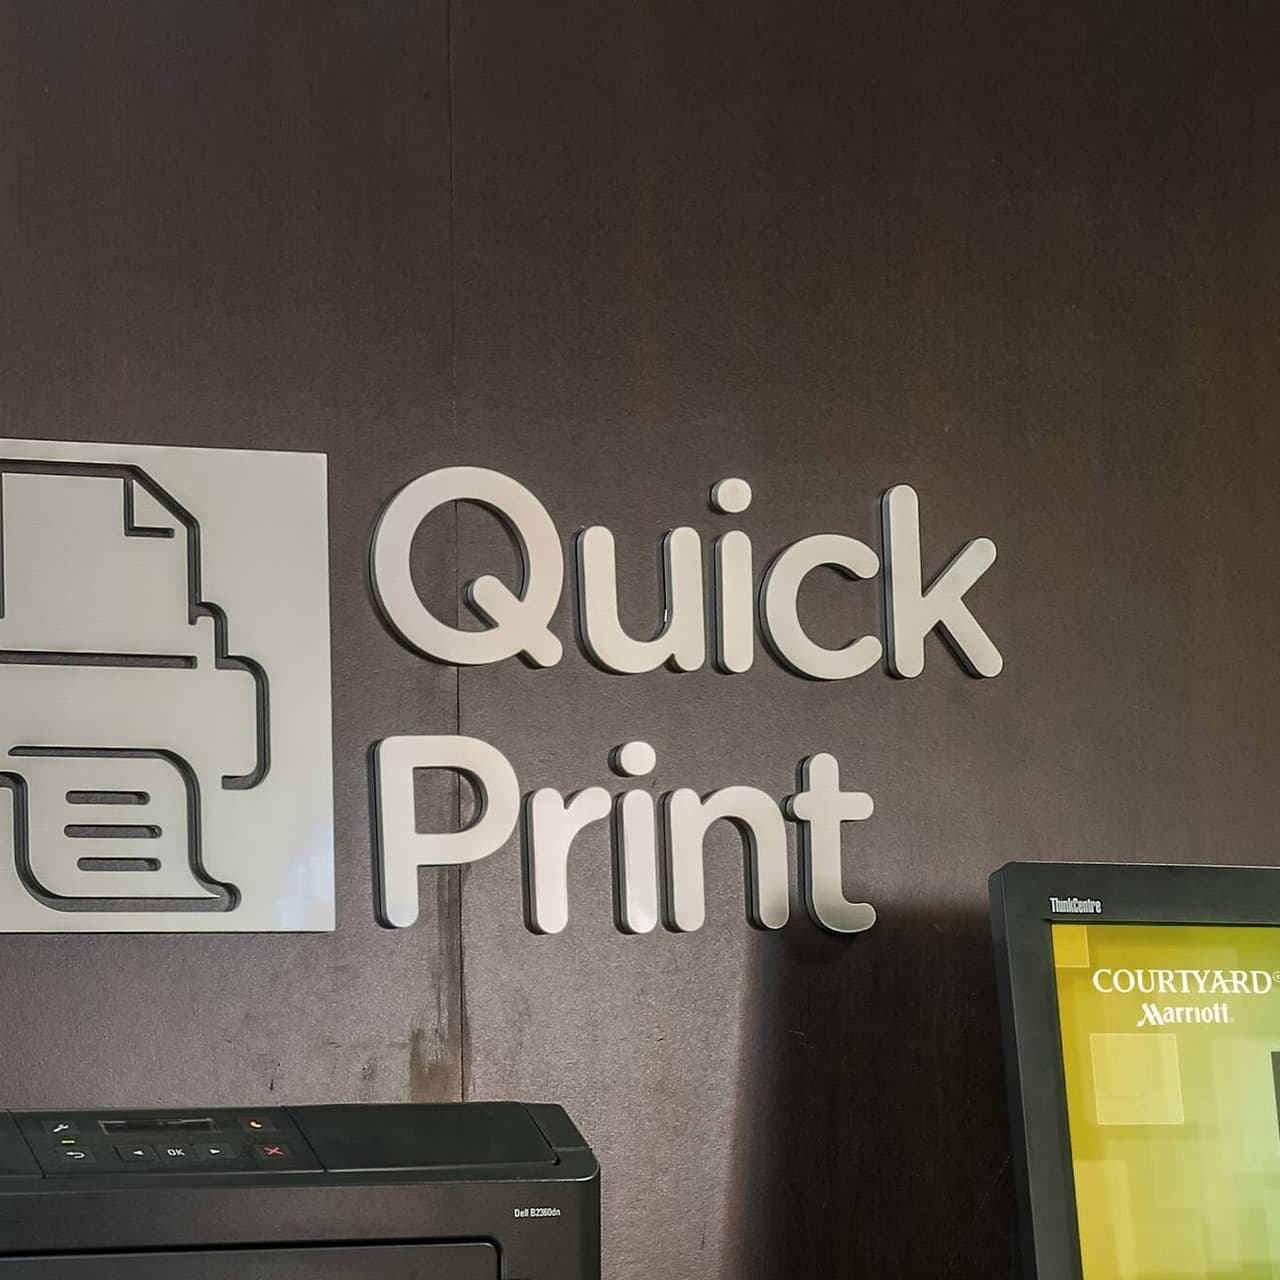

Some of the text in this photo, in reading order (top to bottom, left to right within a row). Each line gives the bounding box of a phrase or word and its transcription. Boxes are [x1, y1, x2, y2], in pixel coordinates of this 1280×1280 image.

[370, 465, 1005, 684] Quick
[373, 735, 878, 936] Print
[1049, 897, 1102, 914] ThinkCentre
[1136, 1002, 1230, 1027] Marriott
[167, 1148, 184, 1157] OK
[514, 1208, 529, 1218] Dell
